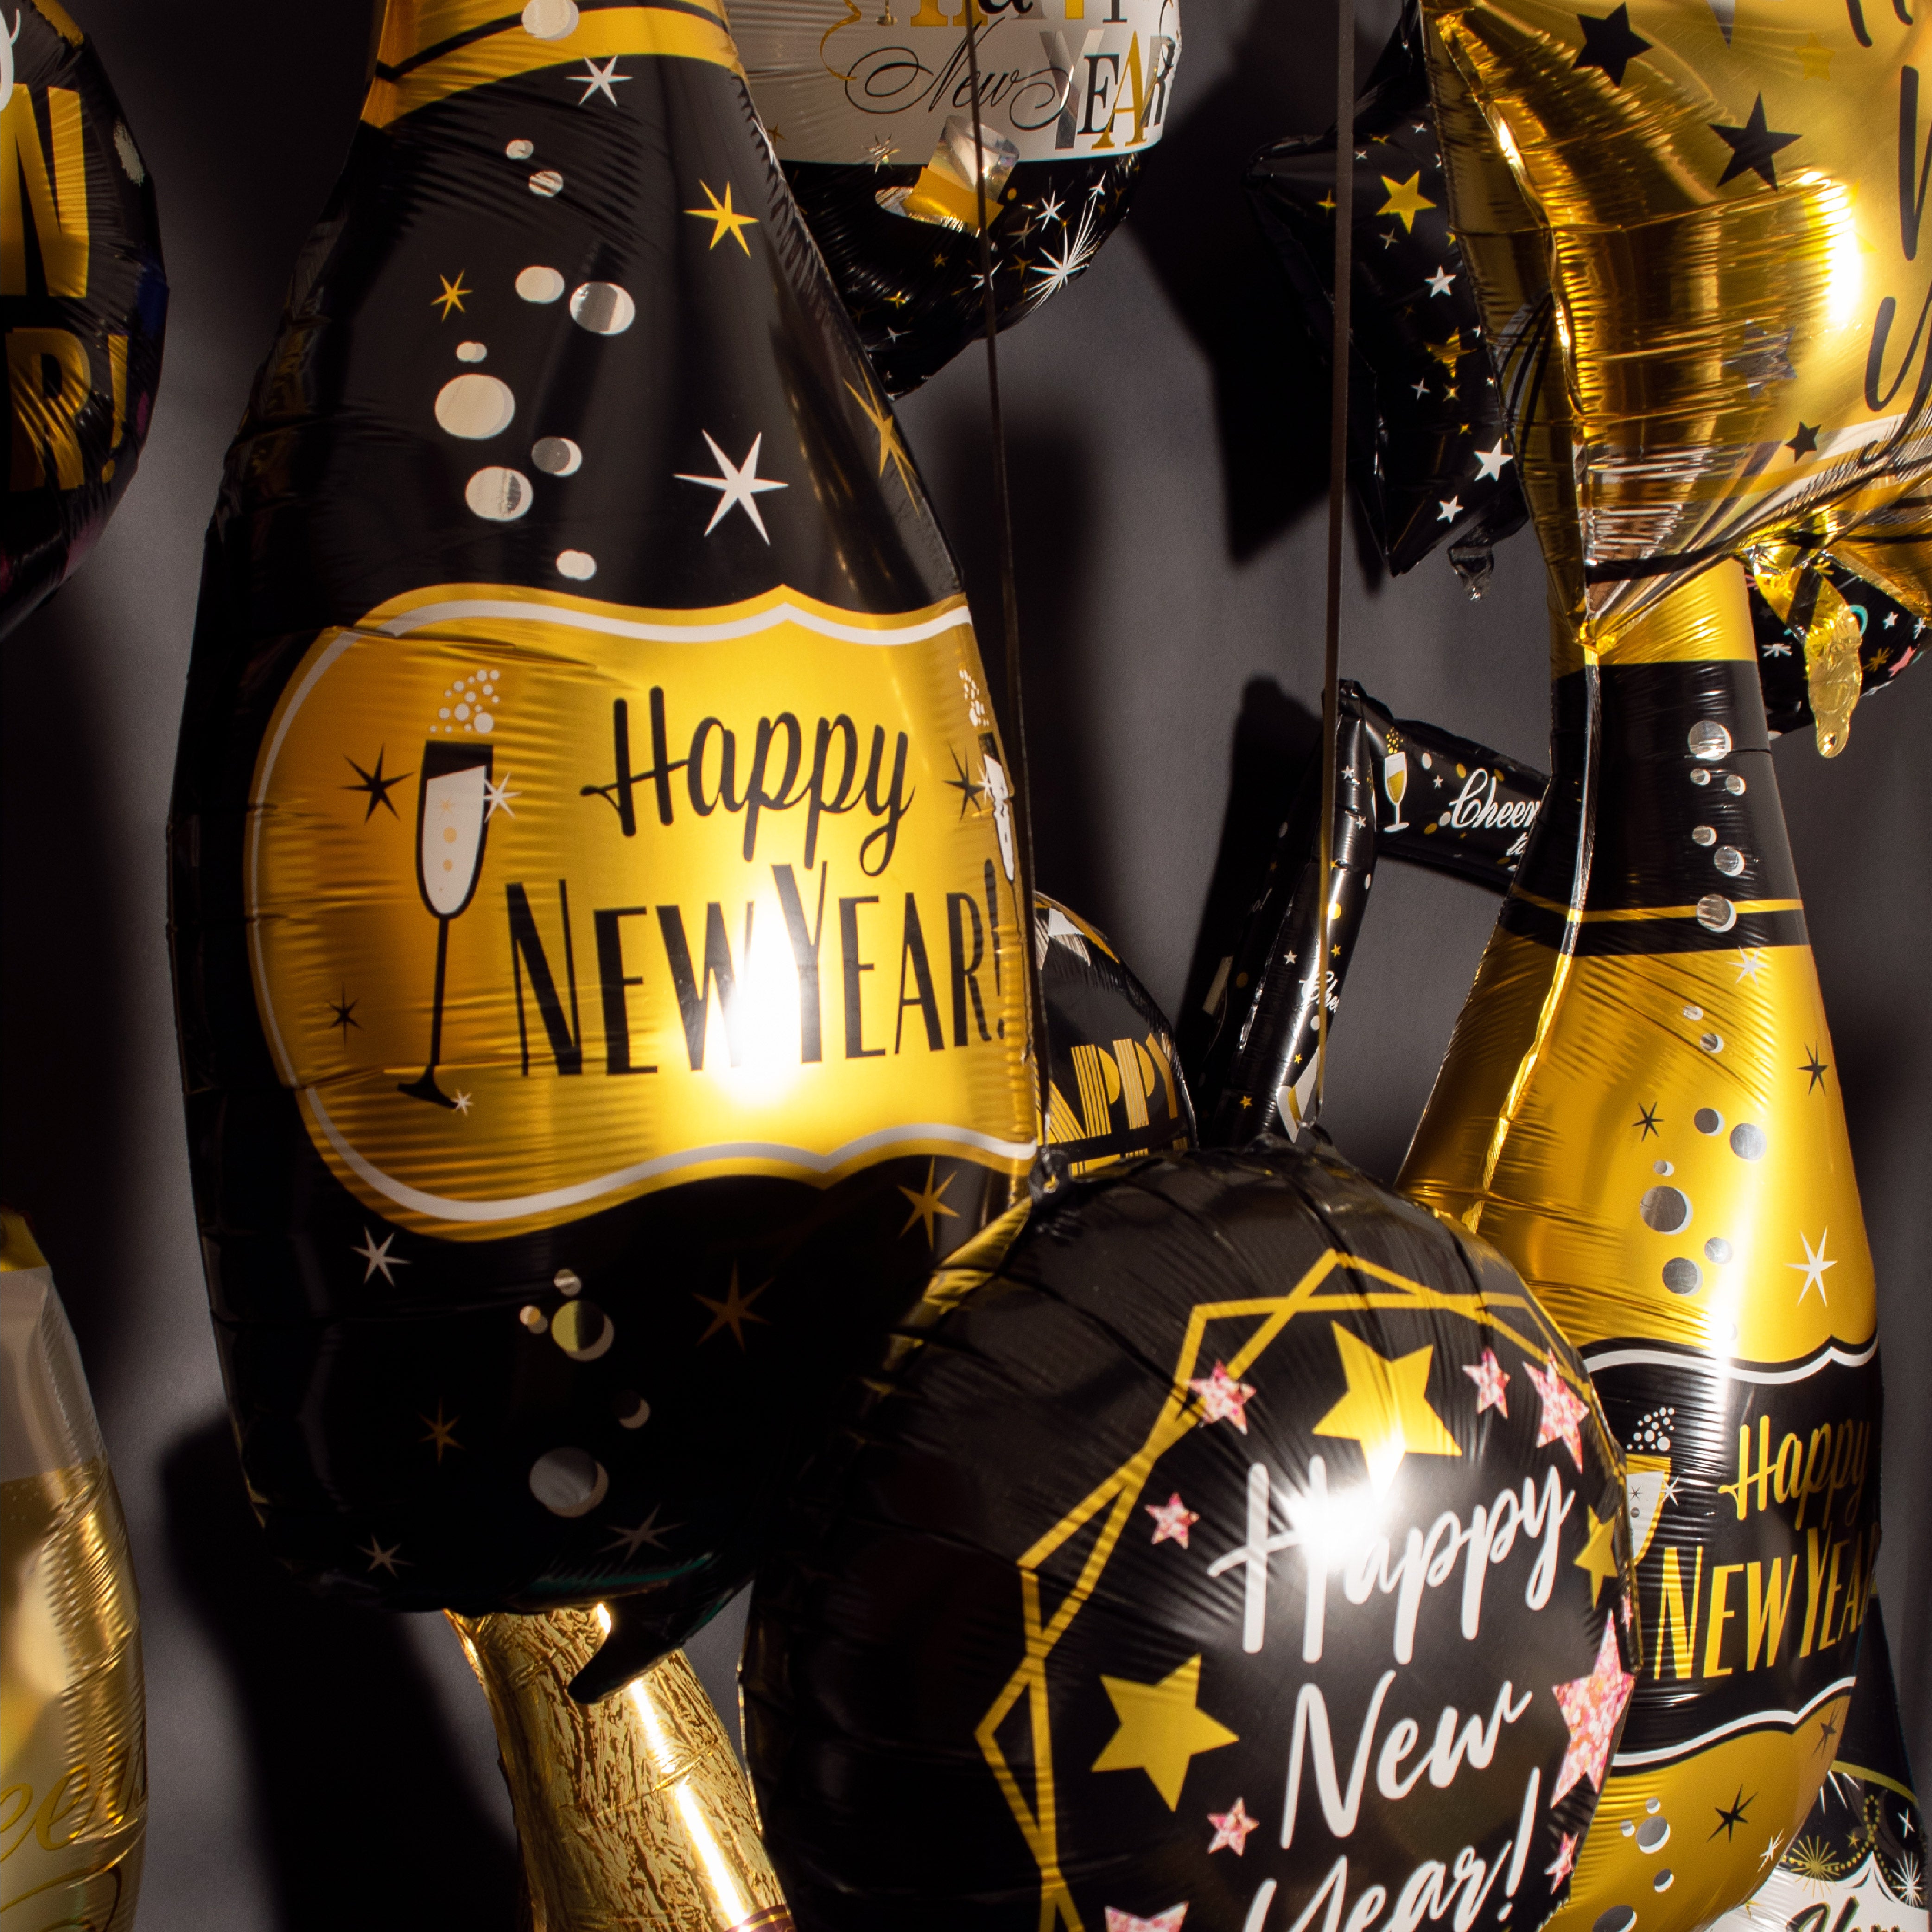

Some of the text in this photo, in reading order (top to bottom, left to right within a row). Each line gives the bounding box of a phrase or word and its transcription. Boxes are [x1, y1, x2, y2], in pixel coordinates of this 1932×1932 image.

[845, 17, 1071, 131] New
[579, 686, 916, 877] Happy
[505, 859, 1006, 1078] NEW YEAR!
[1208, 1454, 1576, 1665] Happy
[1718, 1414, 1871, 1531] Happy
[1653, 1545, 1799, 1680] NEW
[1280, 1670, 1533, 1849] New
